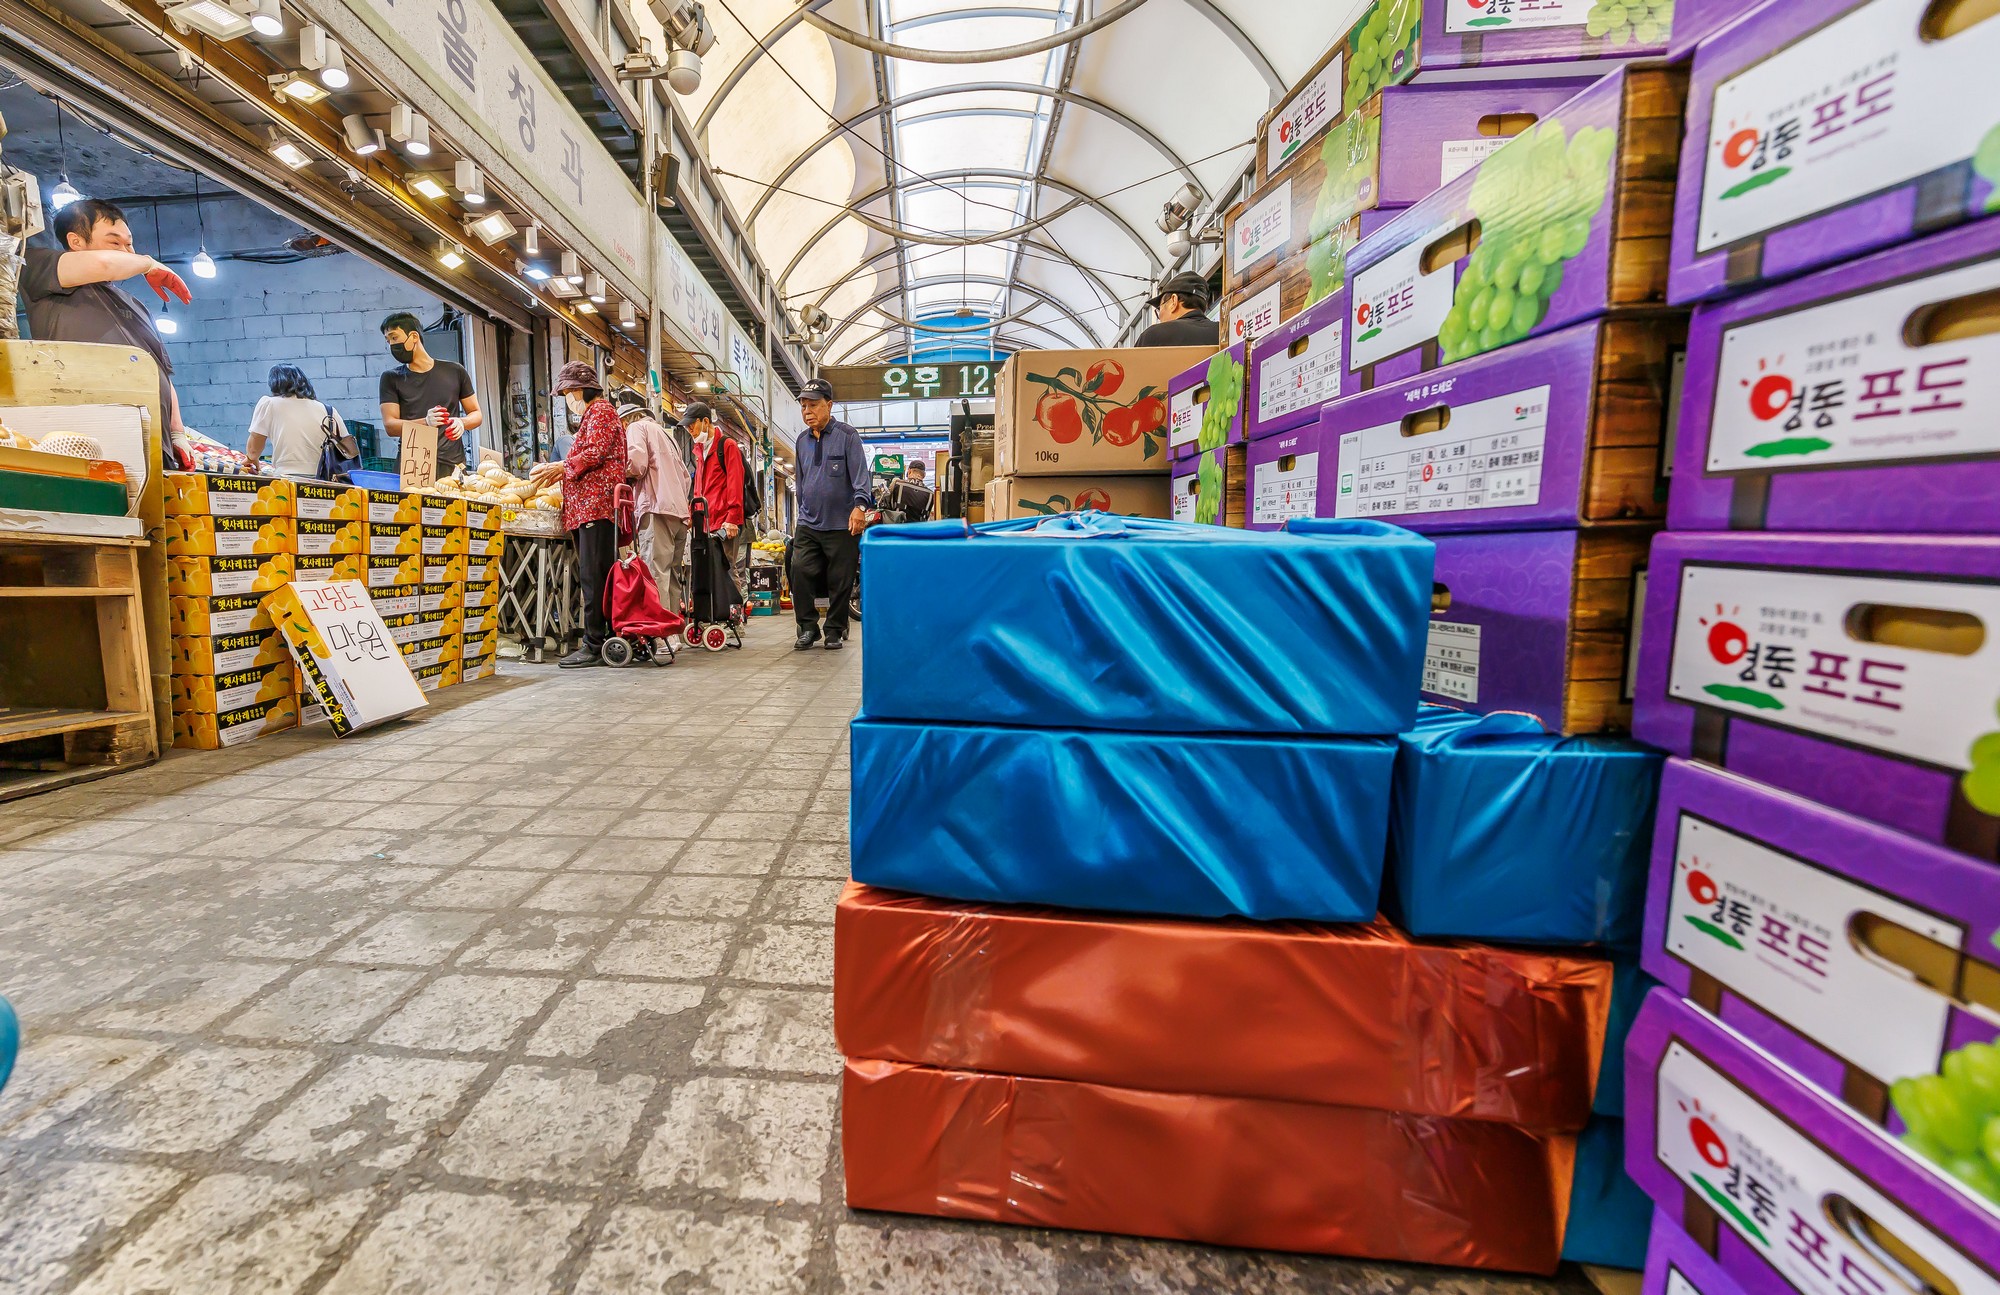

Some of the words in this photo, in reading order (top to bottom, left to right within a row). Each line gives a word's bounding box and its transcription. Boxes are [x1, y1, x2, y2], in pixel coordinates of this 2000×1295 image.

[384, 0, 584, 206] 울청과
[1280, 115, 1302, 143] 영동
[1304, 91, 1326, 129] 포도
[1722, 117, 1800, 171] 영동
[1807, 71, 1896, 145] 포도
[1263, 209, 1282, 237] 포도
[1254, 308, 1272, 331] 포도
[1358, 302, 1384, 328] 영동
[1387, 286, 1414, 318] 포도
[882, 366, 940, 397] 오후
[1422, 388, 1429, 399] 후
[1750, 375, 1844, 431] 영동
[1853, 358, 1969, 420] 포도
[403, 460, 432, 487] 만원
[1035, 451, 1059, 463] 10kg
[1459, 463, 1464, 471] 7
[300, 586, 365, 612] 고당도
[327, 620, 390, 662] 만원
[1707, 622, 1796, 688] 영동
[1803, 651, 1905, 711] 포도
[1686, 870, 1752, 936] 영동
[1758, 914, 1830, 977] 포도
[1689, 1117, 1777, 1228] 영동
